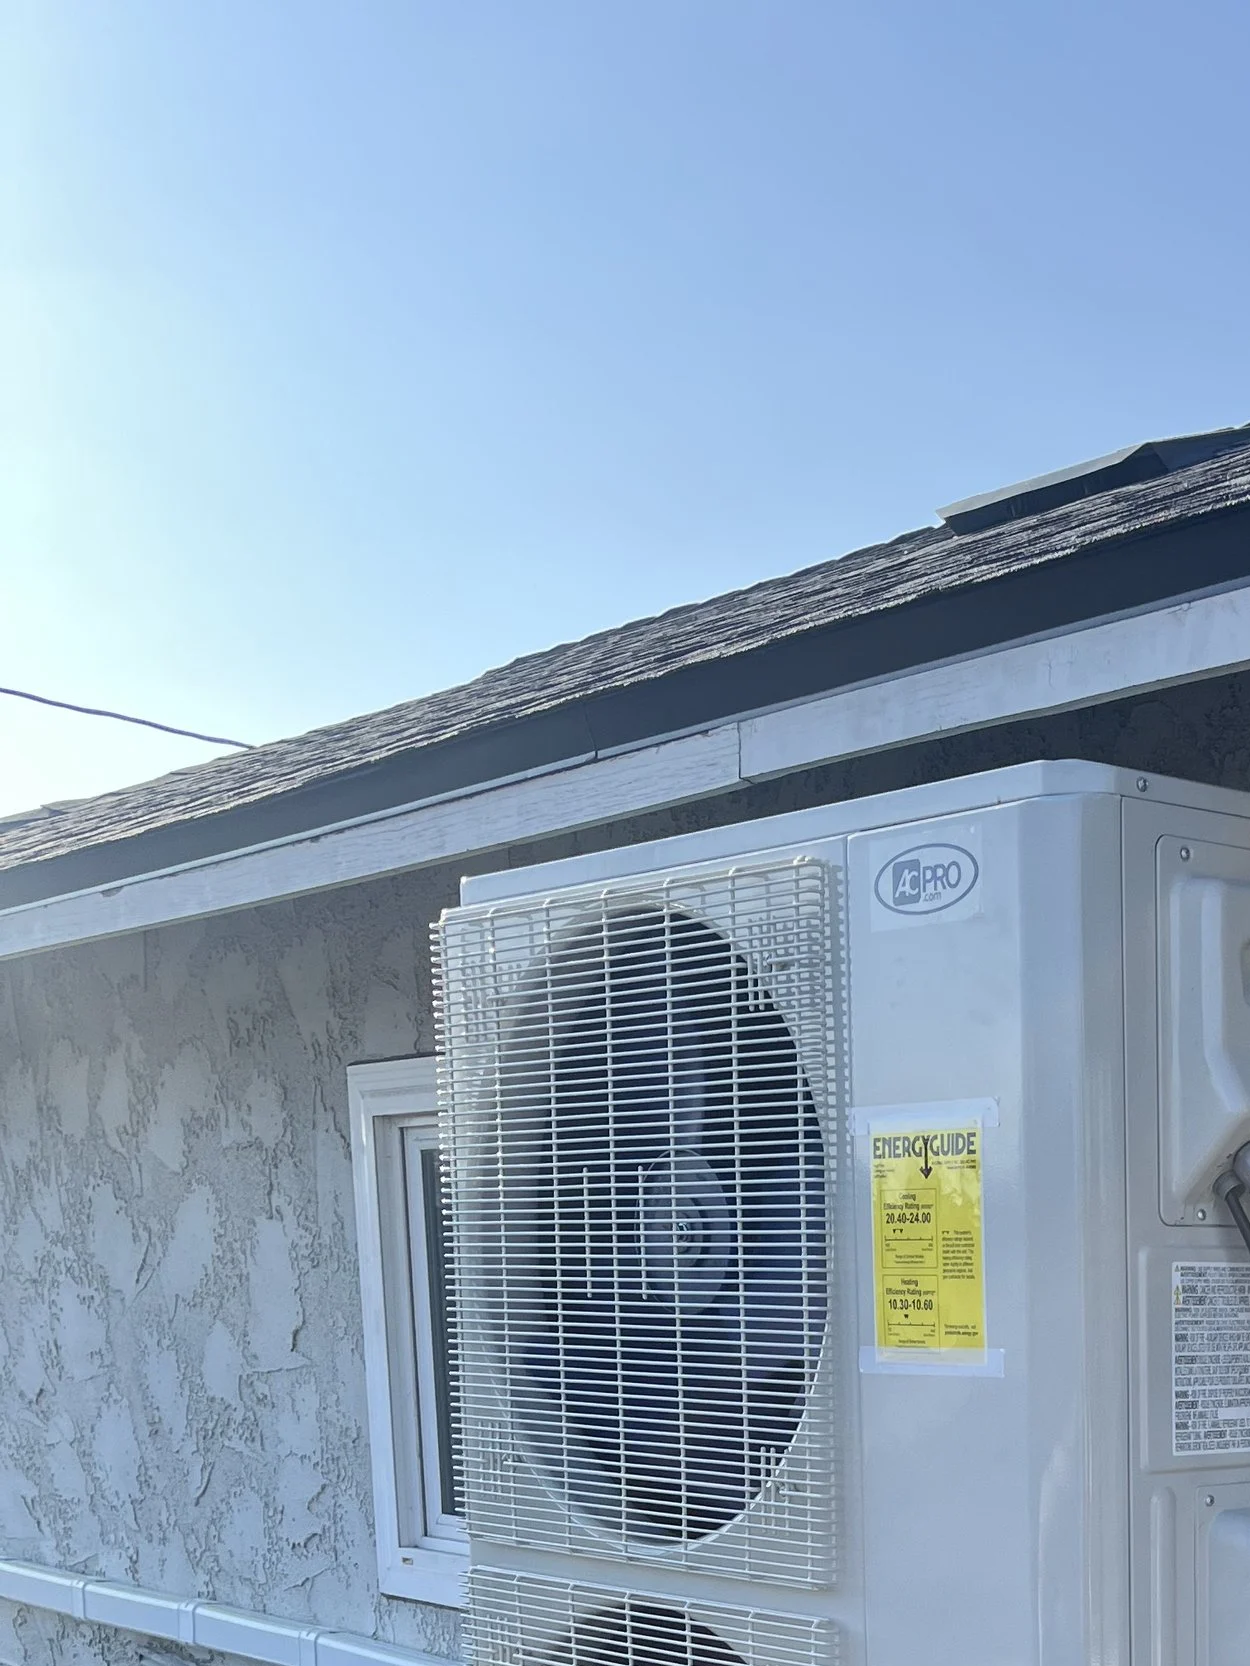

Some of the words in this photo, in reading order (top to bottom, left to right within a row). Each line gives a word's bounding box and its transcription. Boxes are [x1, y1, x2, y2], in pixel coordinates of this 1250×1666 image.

[895, 868, 919, 898] AC
[922, 861, 961, 893] PRO
[923, 892, 942, 902] .com
[873, 1132, 976, 1159] ENERGYGUIDE
[899, 1192, 917, 1202] Cooling
[905, 1201, 920, 1211] Rating
[885, 1212, 931, 1225] 20.40-24.00
[901, 1278, 918, 1288] Heating
[907, 1288, 922, 1298] Rating
[888, 1299, 933, 1311] 10.30-10.60
